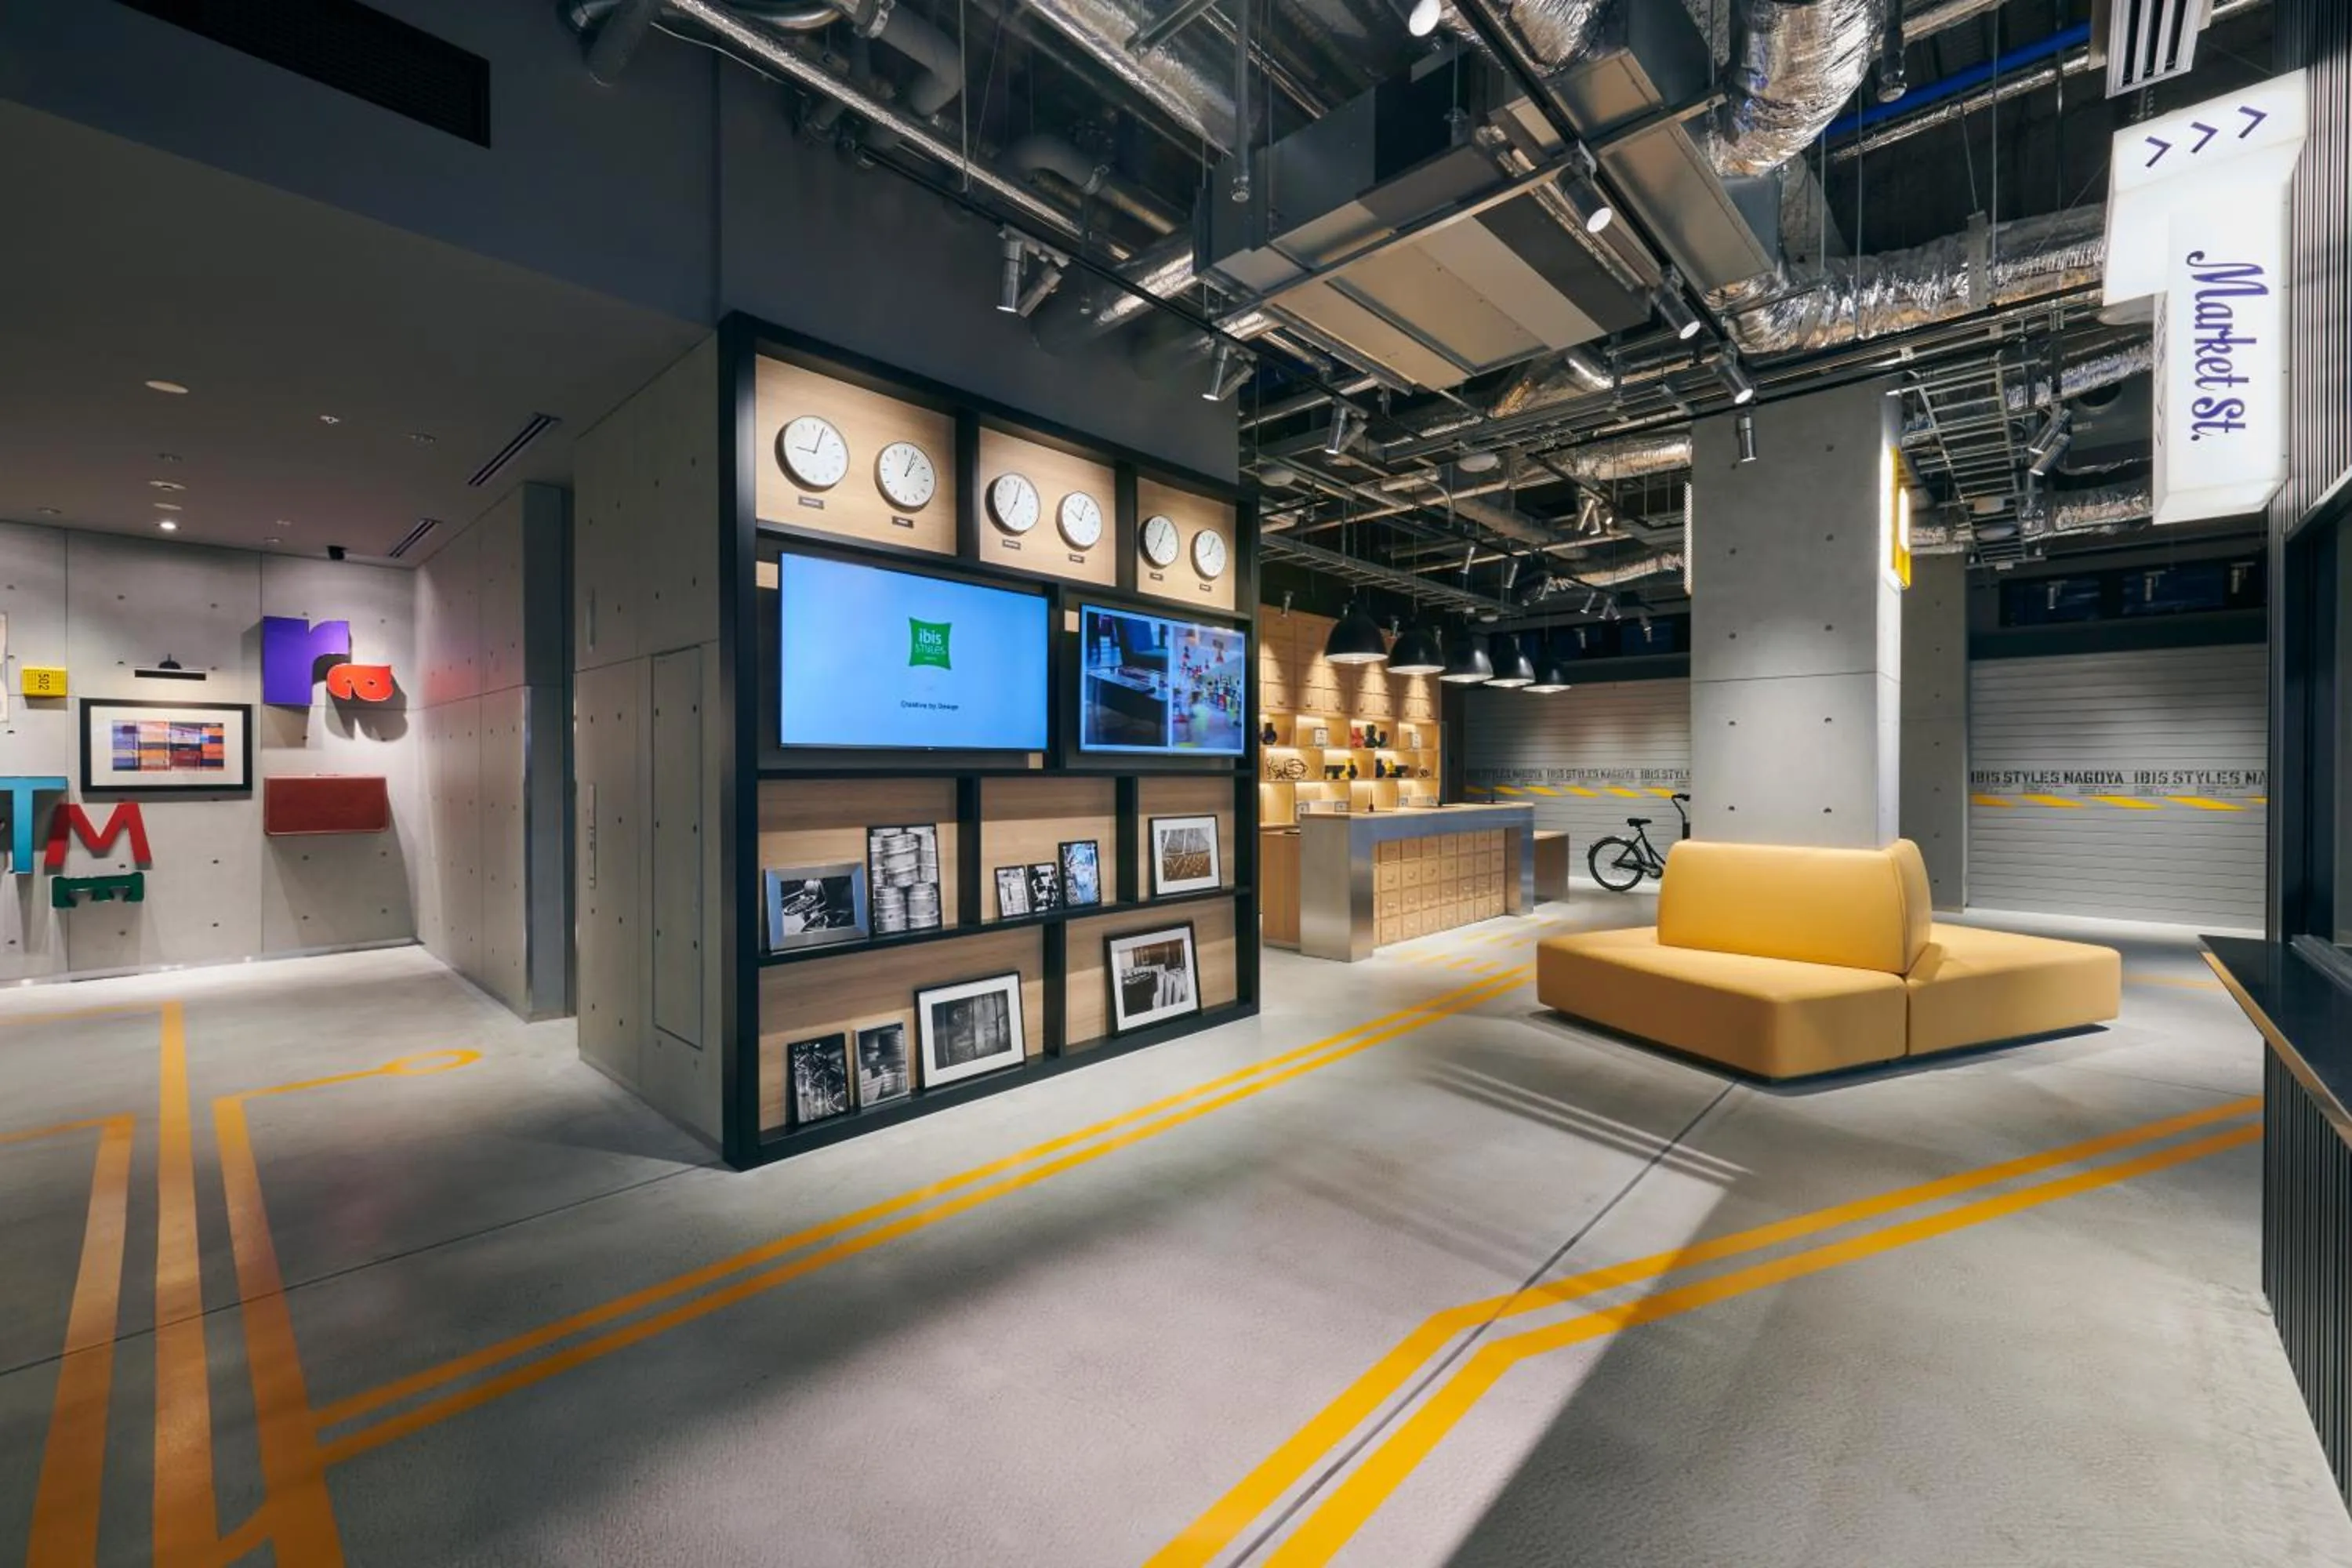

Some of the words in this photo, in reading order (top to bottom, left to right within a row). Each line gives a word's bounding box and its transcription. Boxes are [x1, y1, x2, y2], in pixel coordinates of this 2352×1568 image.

[2186, 250, 2270, 391] Market
[2190, 397, 2247, 441] St.
[1970, 771, 2000, 784] IBIS
[2003, 771, 2060, 784] STYLES
[2063, 771, 2124, 784] NAGOYA
[2134, 770, 2168, 784] IBIS
[2172, 770, 2240, 785] STYLES
